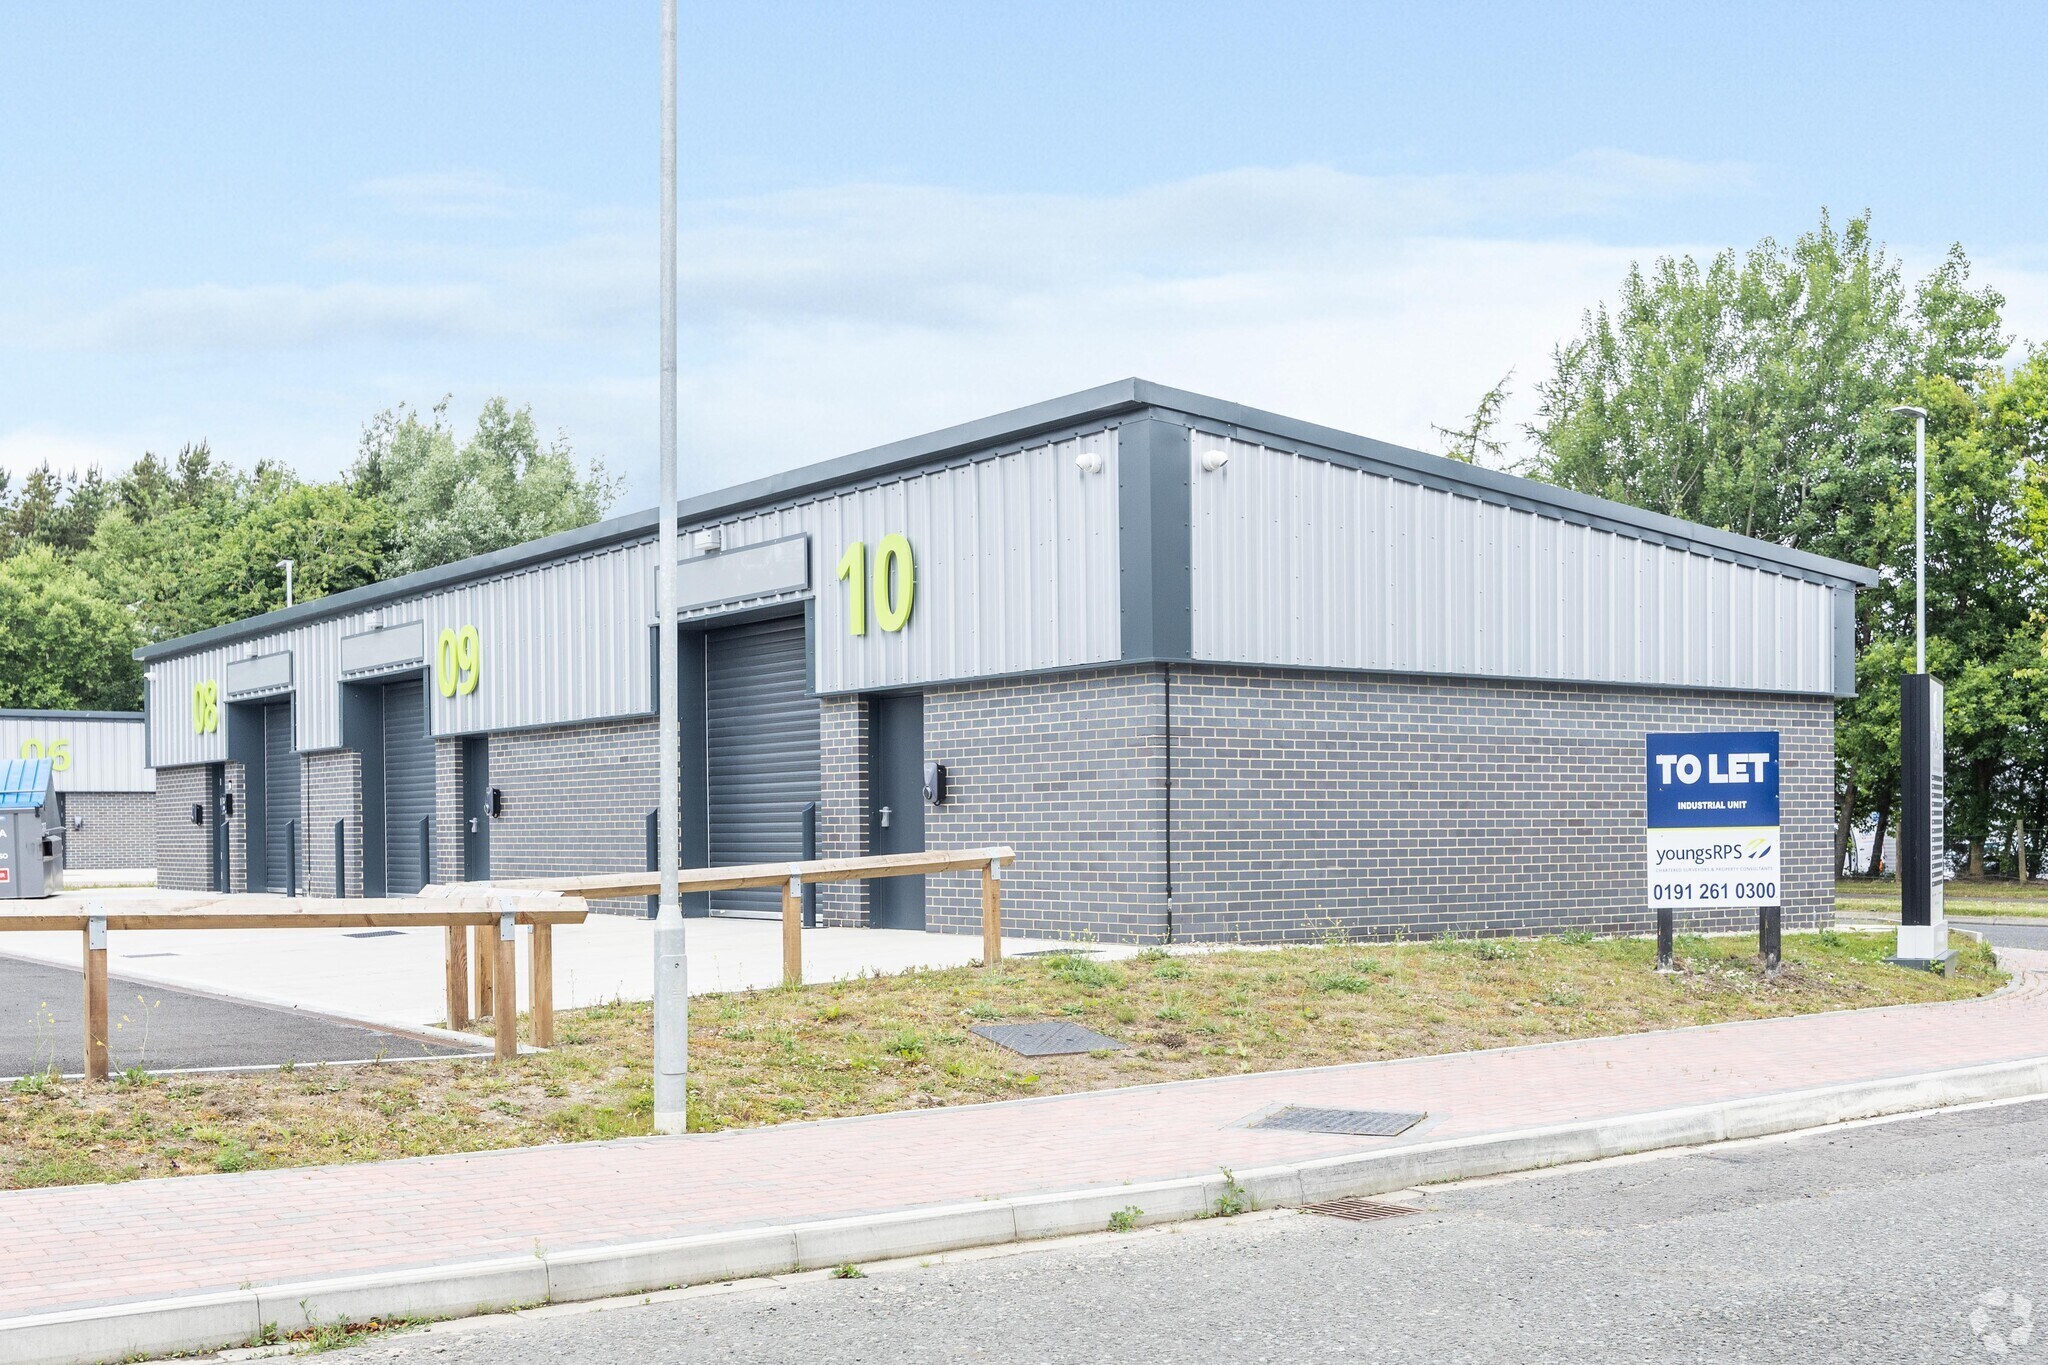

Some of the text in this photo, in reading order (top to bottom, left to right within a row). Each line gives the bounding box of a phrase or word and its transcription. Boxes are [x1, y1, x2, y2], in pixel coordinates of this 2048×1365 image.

[836, 533, 914, 635] 10
[438, 624, 479, 698] 09
[193, 679, 218, 735] 08
[20, 738, 71, 771] 06
[1656, 752, 1770, 785] TO LET
[1677, 800, 1747, 810] INDUSTRIAL UNIT
[1656, 844, 1742, 865] youngsRPS
[1653, 882, 1776, 900] 0191 261 0300
